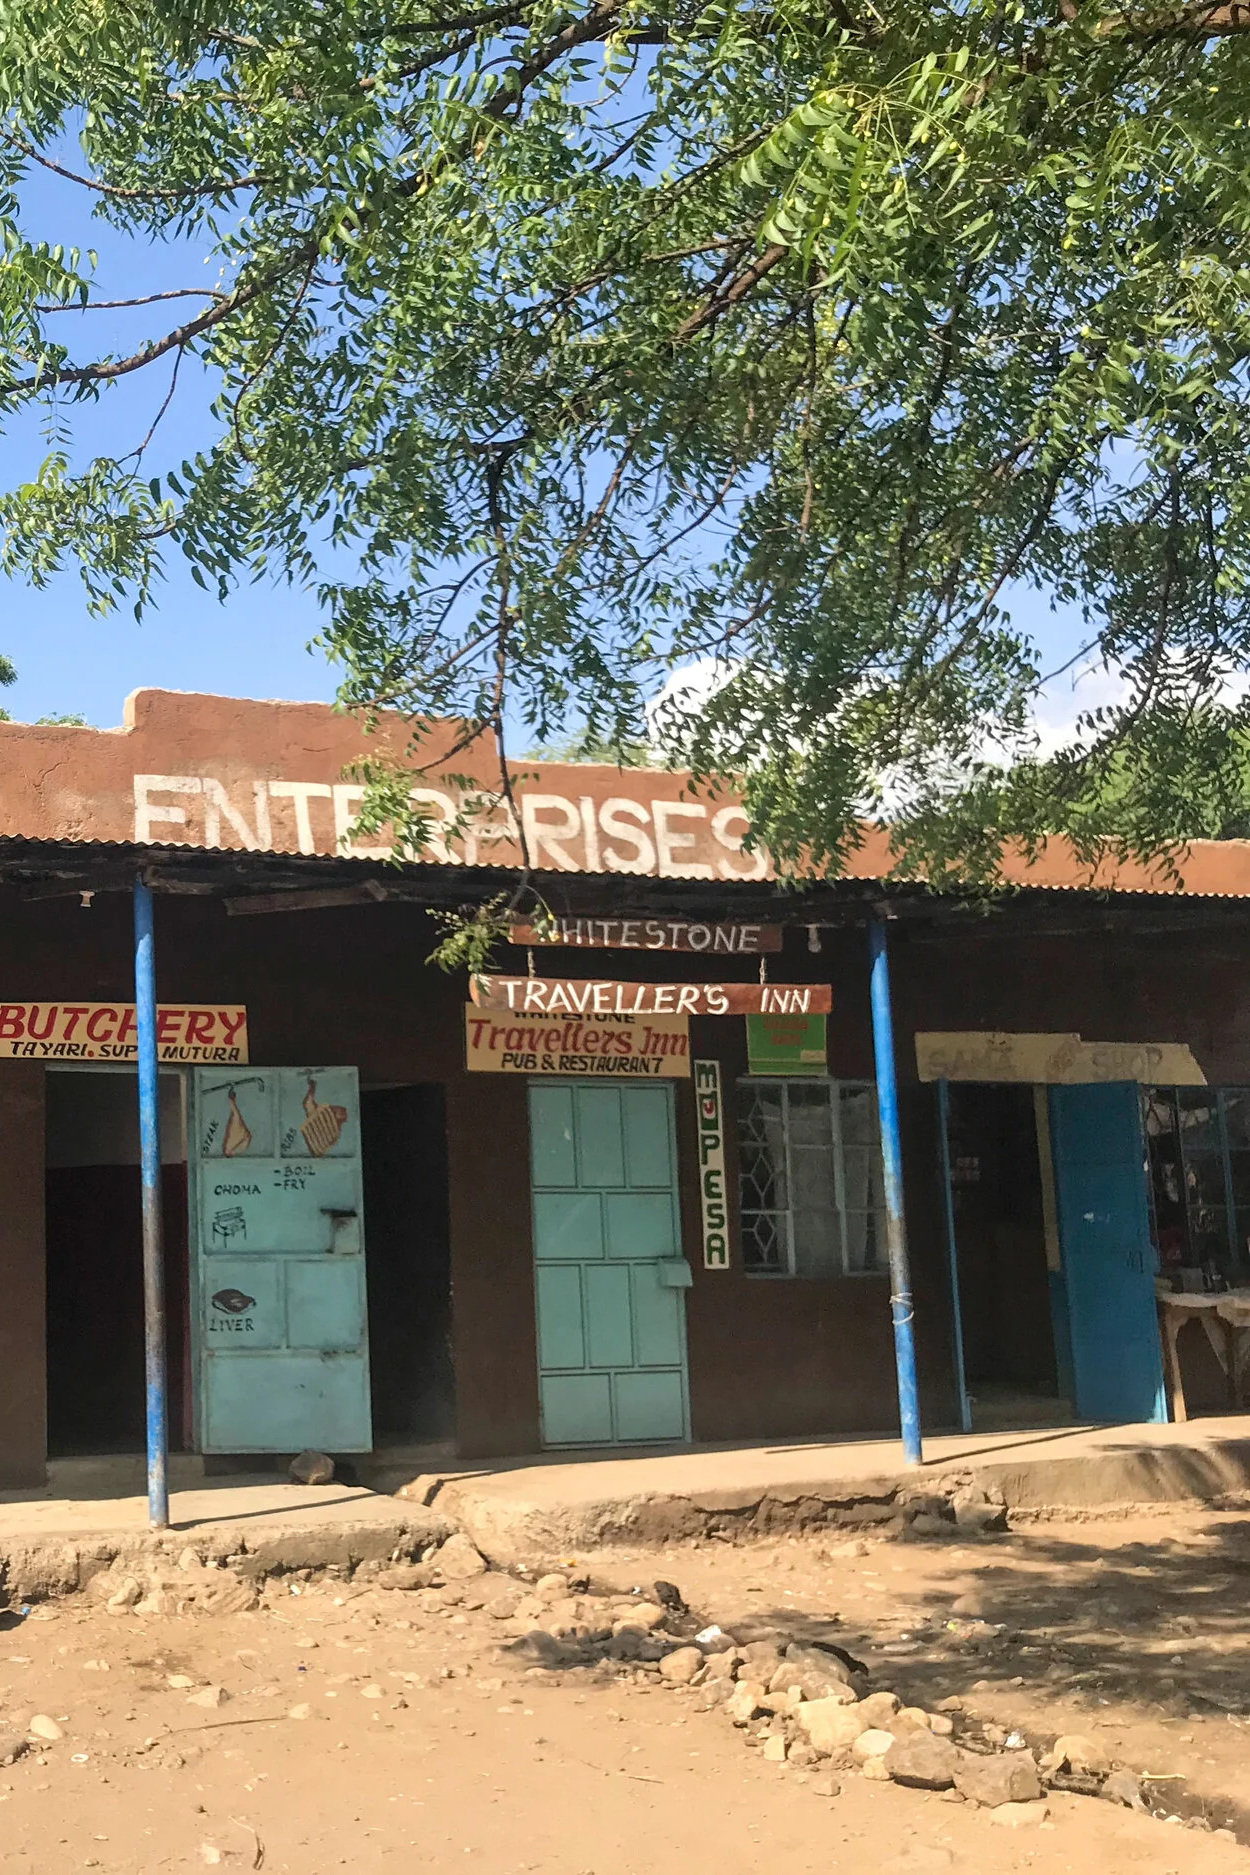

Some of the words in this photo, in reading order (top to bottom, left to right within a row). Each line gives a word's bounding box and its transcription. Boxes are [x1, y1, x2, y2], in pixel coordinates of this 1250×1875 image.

[134, 775, 768, 881] ENTERPRISES
[499, 980, 730, 1015] TRAVELLER'S
[760, 987, 811, 1014] INN
[468, 1019, 633, 1054] Travellers
[639, 1025, 689, 1056] Inn
[99, 1044, 159, 1058] SUP
[162, 1046, 240, 1061] MUTURA
[502, 1053, 537, 1070] PUB
[541, 1054, 556, 1071] &
[559, 1055, 663, 1074] RESTAURANT
[214, 1184, 262, 1196] CHOMA
[209, 1318, 255, 1332] LIVER
